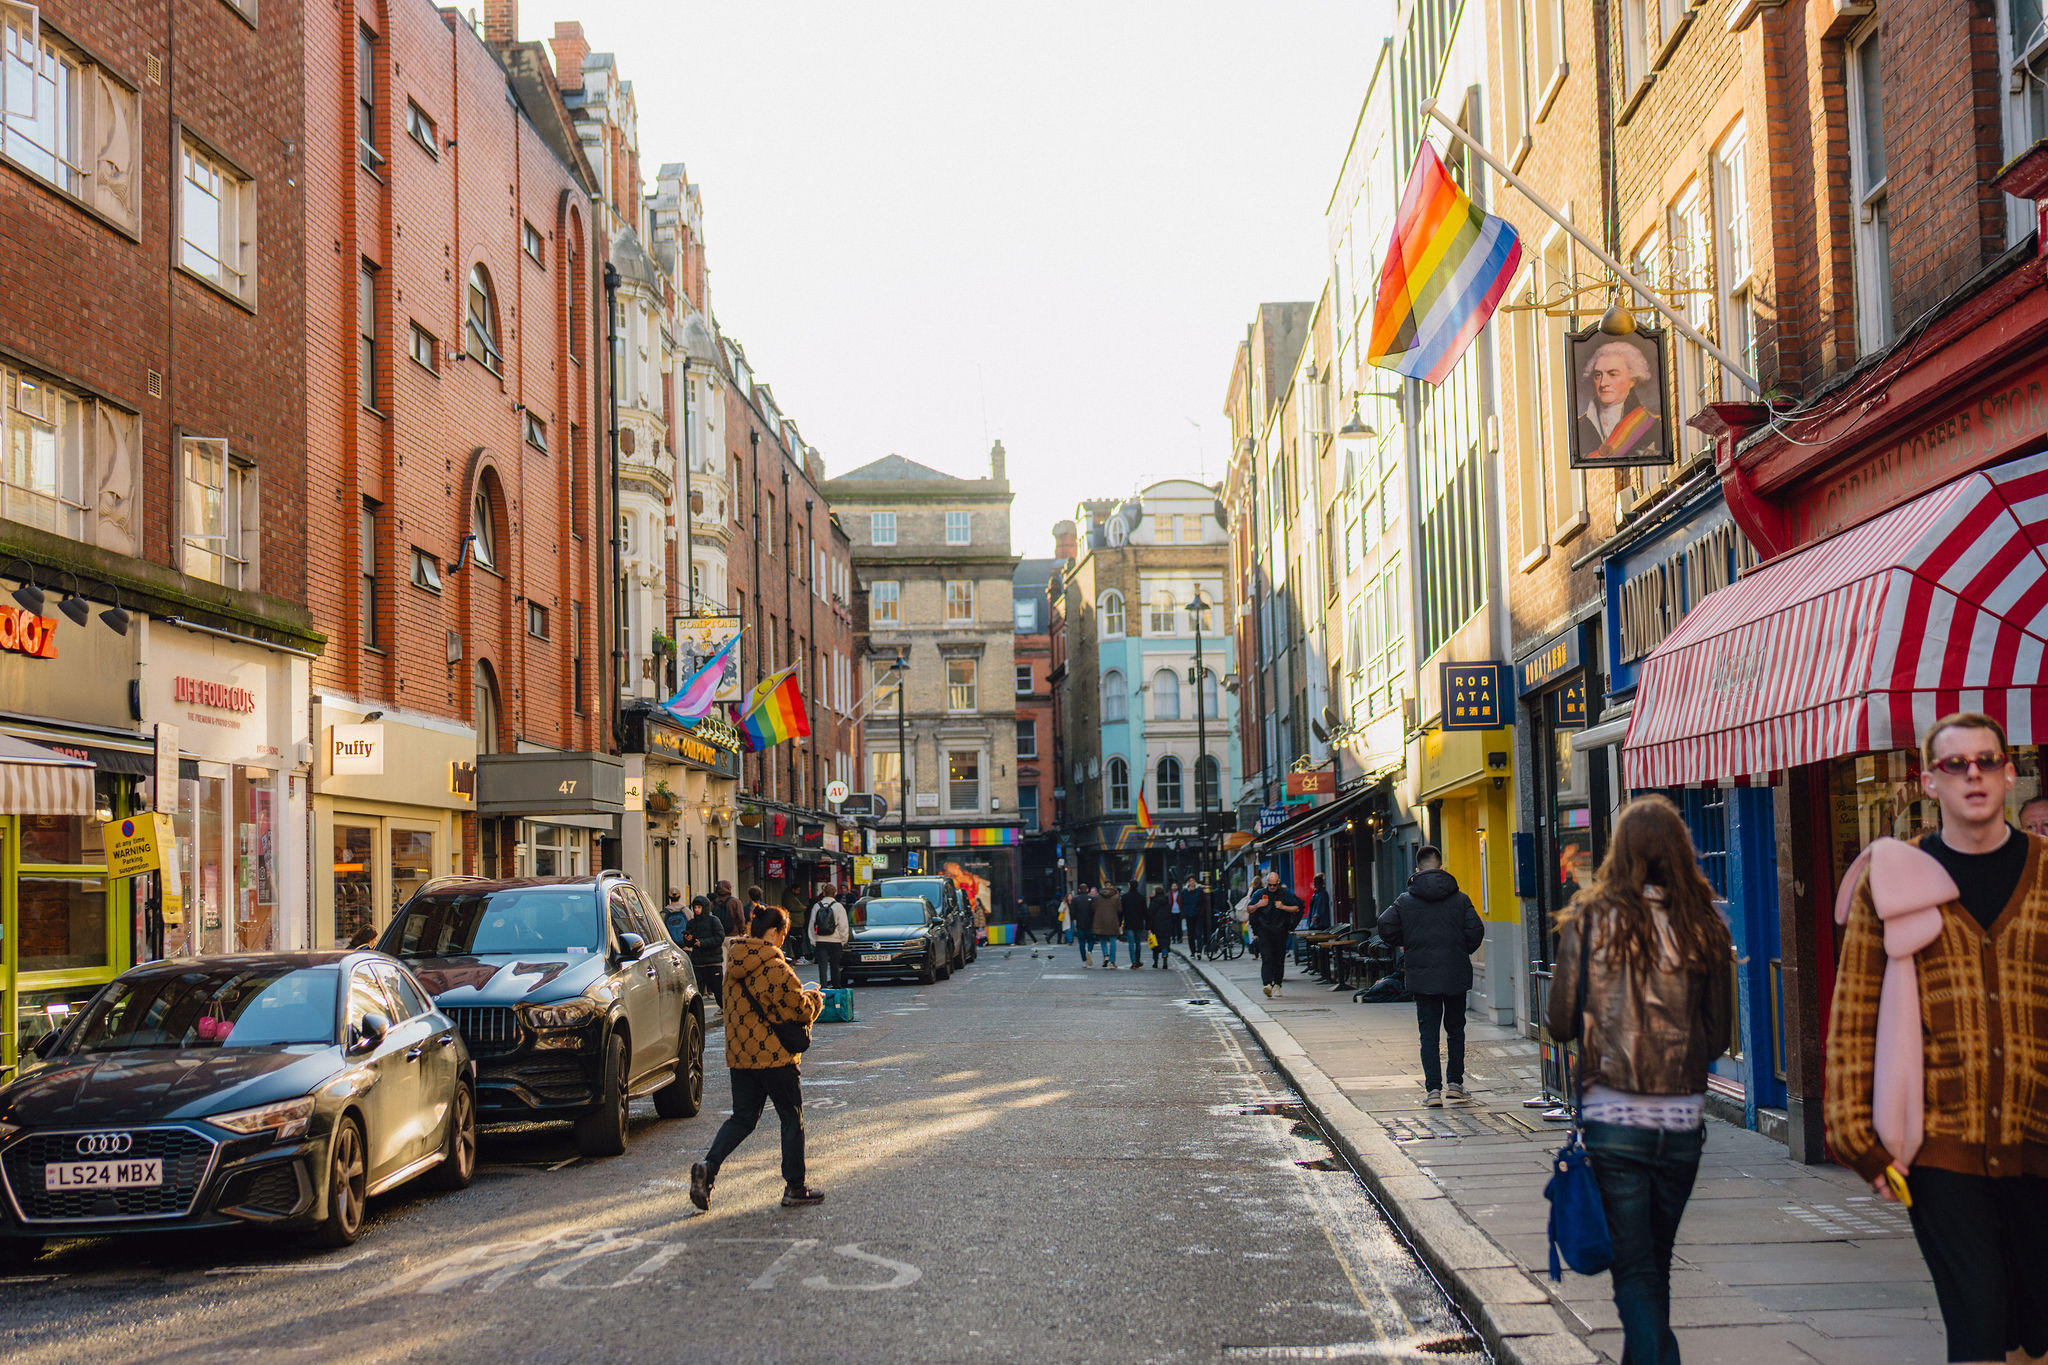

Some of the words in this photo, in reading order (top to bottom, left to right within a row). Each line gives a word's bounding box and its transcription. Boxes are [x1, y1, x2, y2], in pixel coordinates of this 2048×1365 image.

[1807, 453, 1894, 542] ALGERIAN
[1899, 411, 1977, 491] COFFEE
[1686, 518, 1759, 611] DUNCA
[678, 618, 738, 629] COMPTONS
[1455, 675, 1489, 687] ROB
[175, 675, 200, 705] LIFE
[200, 680, 231, 709] FOUR
[230, 686, 255, 714] CUTS
[1456, 690, 1490, 702] ATA
[335, 740, 373, 758] Puffy
[558, 780, 577, 794] 47
[1302, 775, 1319, 790] 64
[829, 787, 845, 797] AV
[1145, 826, 1199, 836] VILLAGE
[115, 841, 122, 849] at
[122, 839, 132, 848] any
[133, 836, 146, 844] time
[113, 843, 151, 860] WARNING
[122, 856, 143, 866] Parking
[119, 862, 150, 875] suspension
[59, 1164, 111, 1186] LS24
[117, 1162, 156, 1183] MBX
